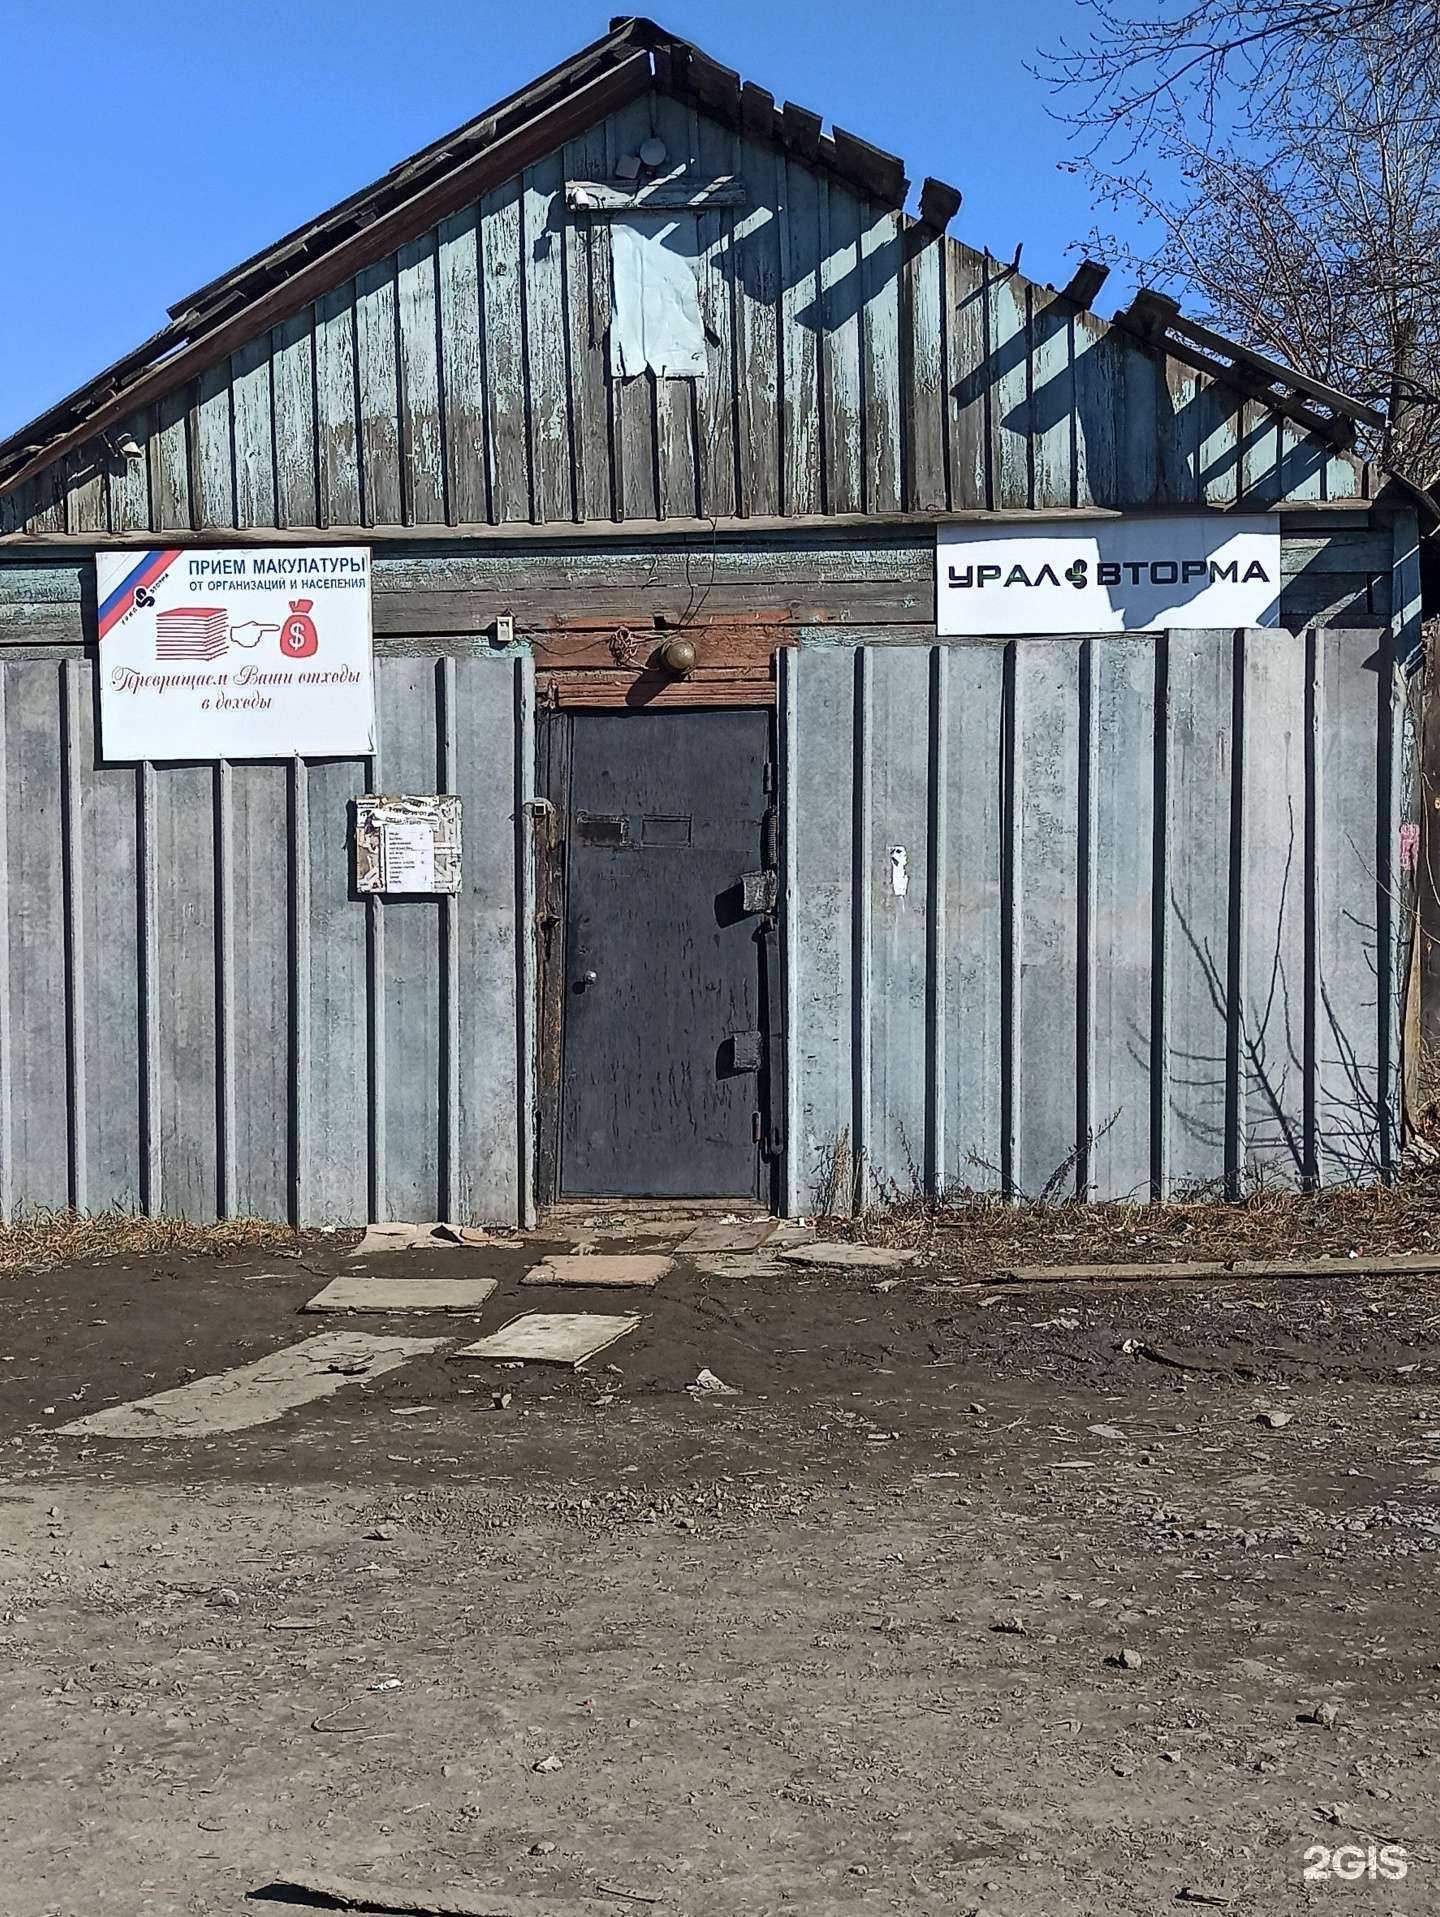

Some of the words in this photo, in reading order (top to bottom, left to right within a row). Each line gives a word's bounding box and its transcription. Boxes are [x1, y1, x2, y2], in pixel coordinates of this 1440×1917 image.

[189, 559, 246, 575] ПРИЕМ
[253, 556, 366, 575] МАКУЛАТУРЫ
[948, 564, 1060, 588] УРАЛ
[1097, 560, 1270, 585] ВТОРМА
[189, 580, 201, 592] ОТ
[290, 579, 298, 590] И
[111, 666, 229, 694] Превращаем
[232, 664, 293, 686] Ваши
[298, 663, 361, 684] отходы
[201, 698, 210, 711] в
[215, 690, 273, 711] доходы
